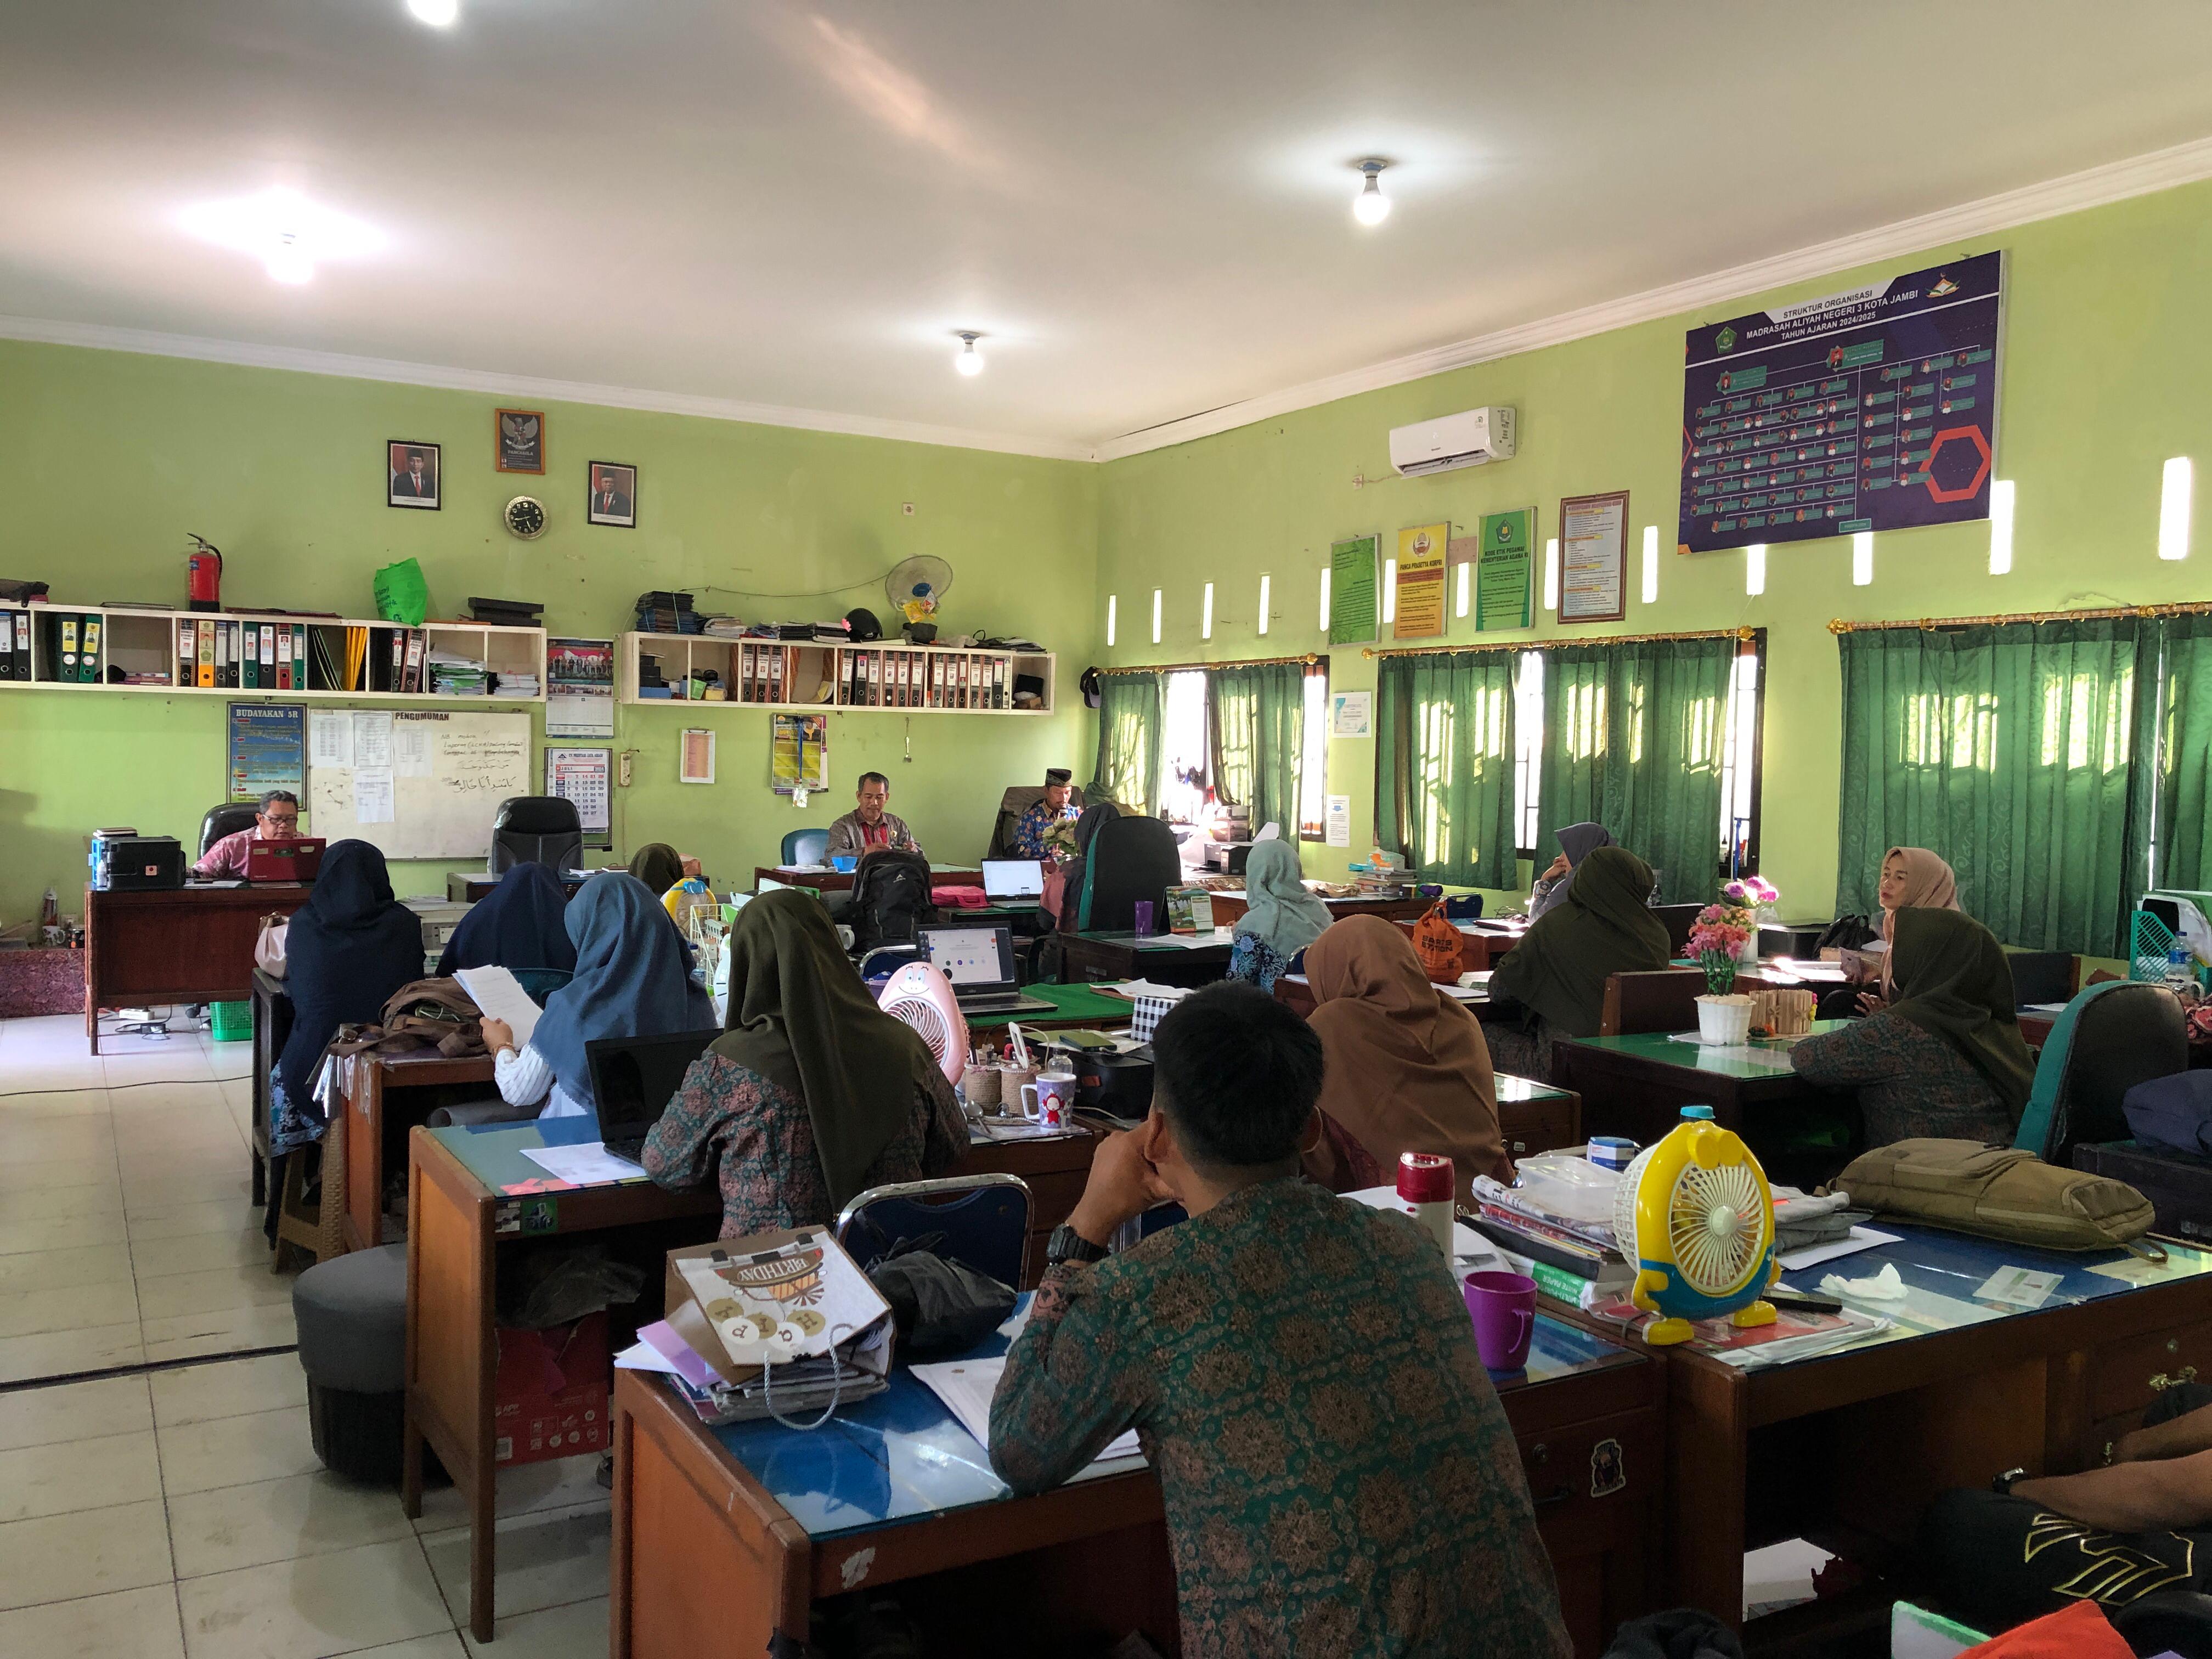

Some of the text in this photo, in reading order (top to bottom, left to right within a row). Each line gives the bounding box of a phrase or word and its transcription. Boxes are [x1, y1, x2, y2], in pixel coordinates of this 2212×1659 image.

[1747, 323, 1790, 339] MADRASAH
[1792, 315, 1820, 329] ALIYAH
[1824, 306, 1855, 320] NEGERI
[1865, 298, 1888, 310] KOTA
[1891, 290, 1918, 304] JAMBI
[1784, 290, 1872, 319] STRUKTUR ORGANISASI
[1781, 311, 1876, 340] TAHUN AJARAN 2024/2025
[1481, 555, 1508, 563] KEMENTERIAN
[236, 709, 284, 718] BUDAYAKAN
[395, 712, 450, 721] PENGUMUMAN
[740, 1258, 808, 1282] BIRTHDAY
[1542, 1275, 1577, 1295] WHITE PAPER
